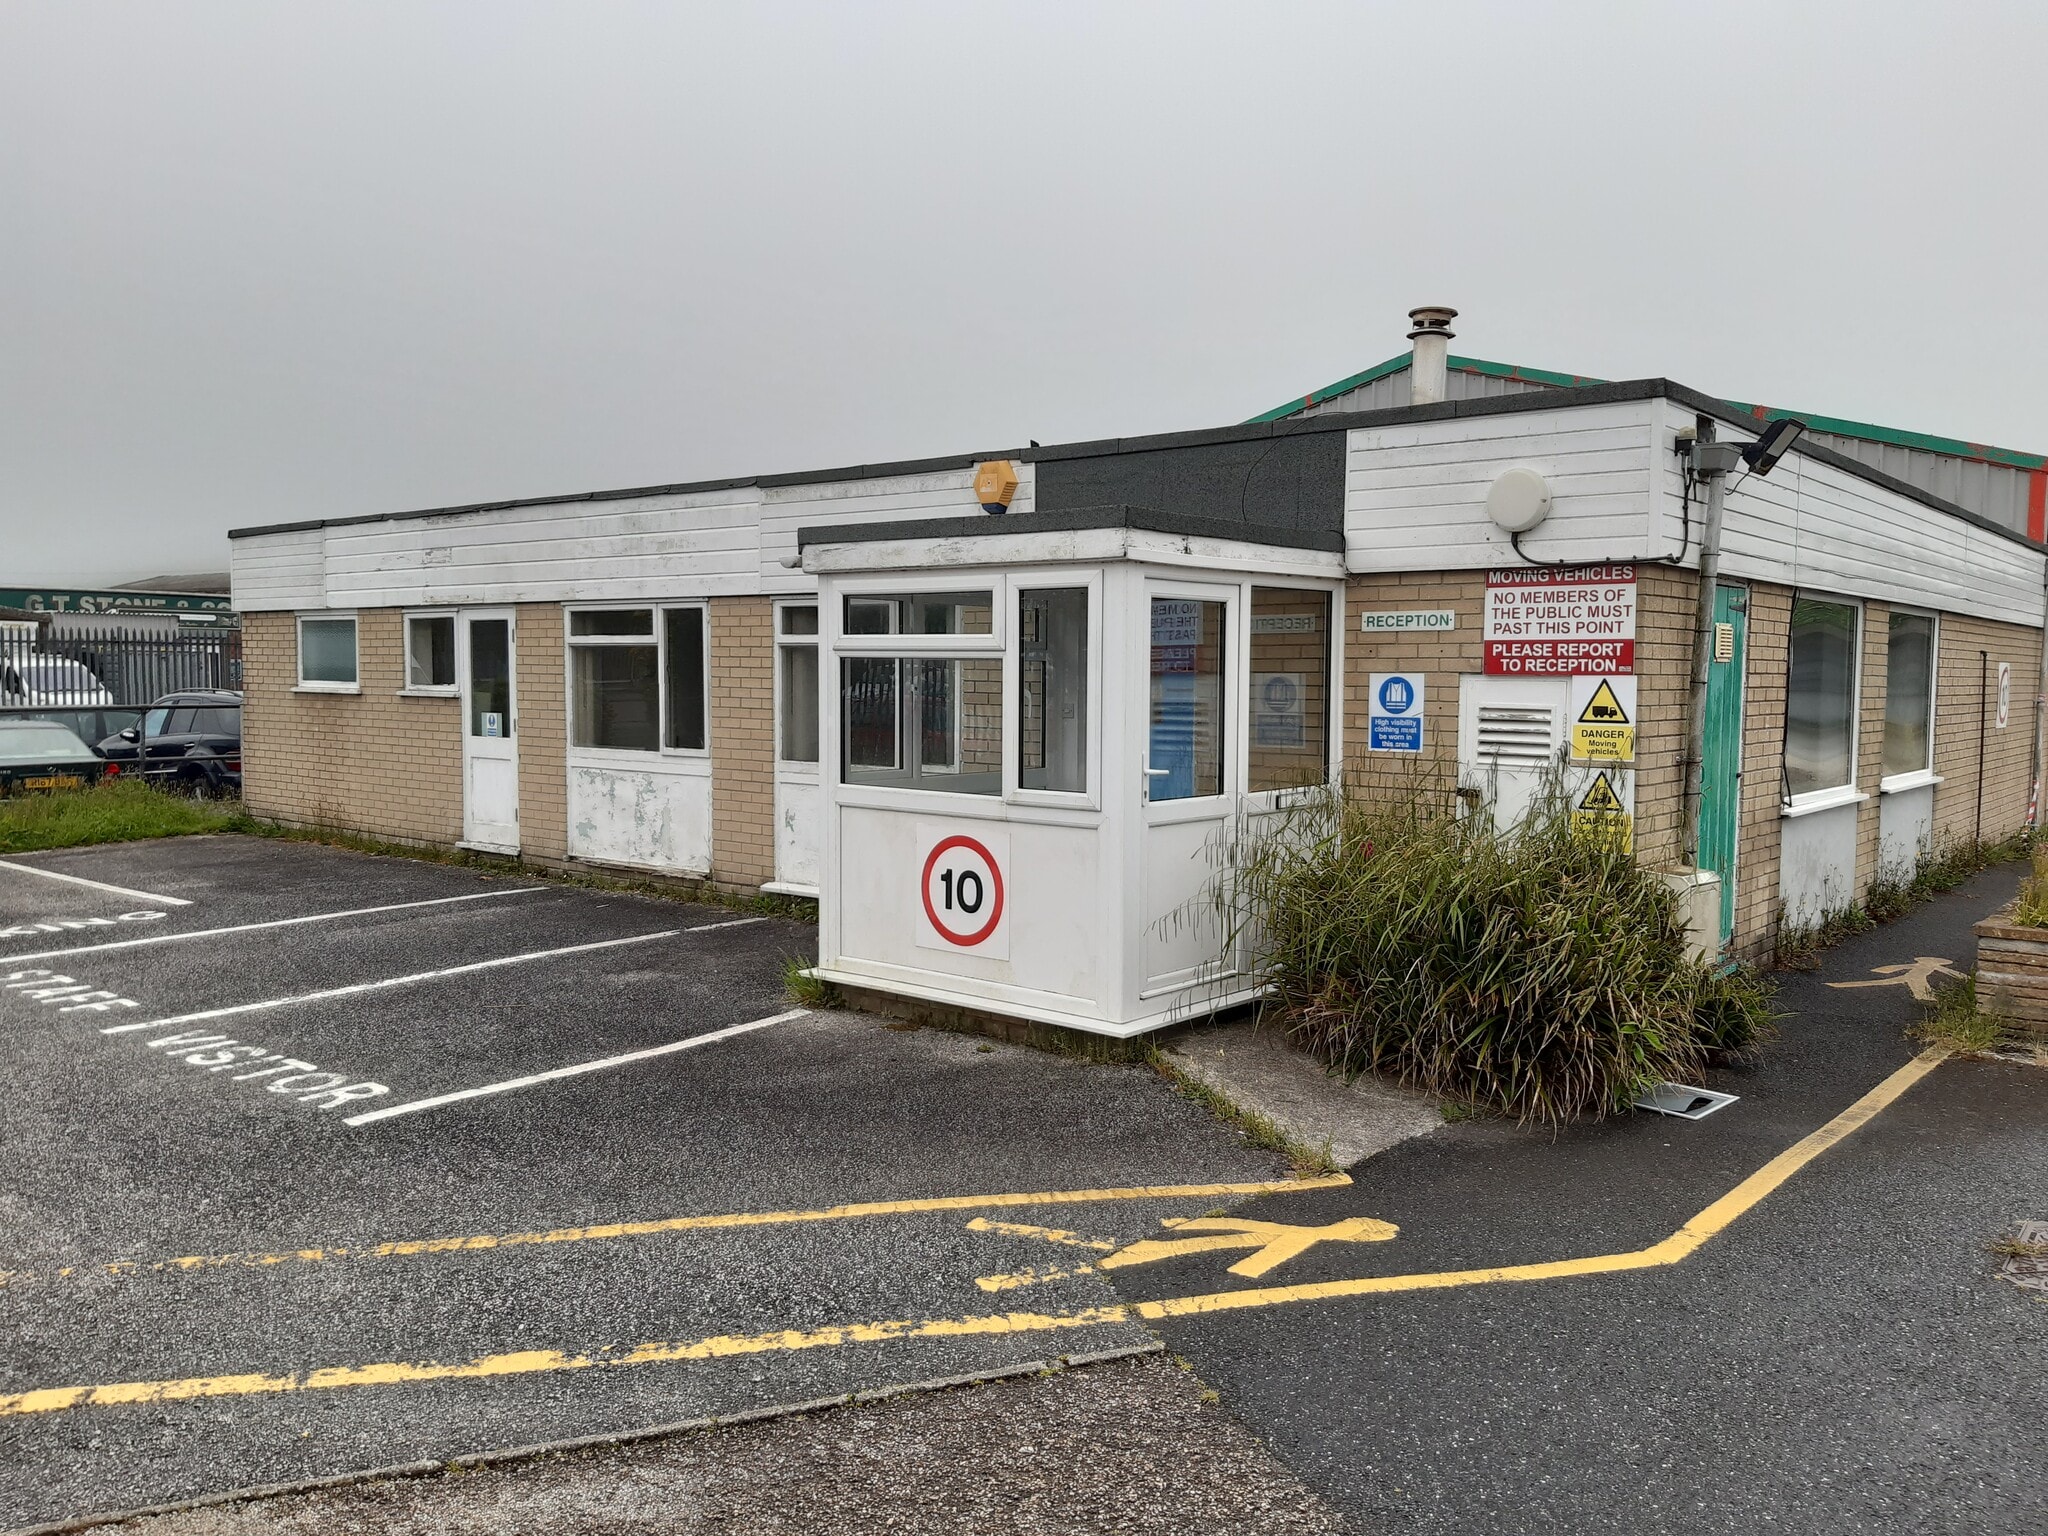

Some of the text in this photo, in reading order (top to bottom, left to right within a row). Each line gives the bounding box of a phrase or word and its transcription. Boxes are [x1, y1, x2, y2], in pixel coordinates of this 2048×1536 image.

[1488, 566, 1633, 584] MOVING VEHICLES
[1493, 588, 1626, 605] NO MEMBERS OF
[1491, 604, 1633, 620] THE PUBLIC MUST
[1366, 614, 1450, 628] RECEPTION
[1493, 620, 1625, 635] PAST THIS POINT
[1492, 642, 1624, 657] PLEASE REPORT
[1500, 659, 1521, 672] TO
[1525, 659, 1616, 672] RECEPTION
[1374, 719, 1417, 727] High visibility
[1374, 726, 1399, 734] clothing
[1581, 729, 1625, 739] DANGER
[1588, 740, 1617, 748] Moving
[940, 868, 983, 914] 10
[147, 1029, 390, 1109] VISITOR
